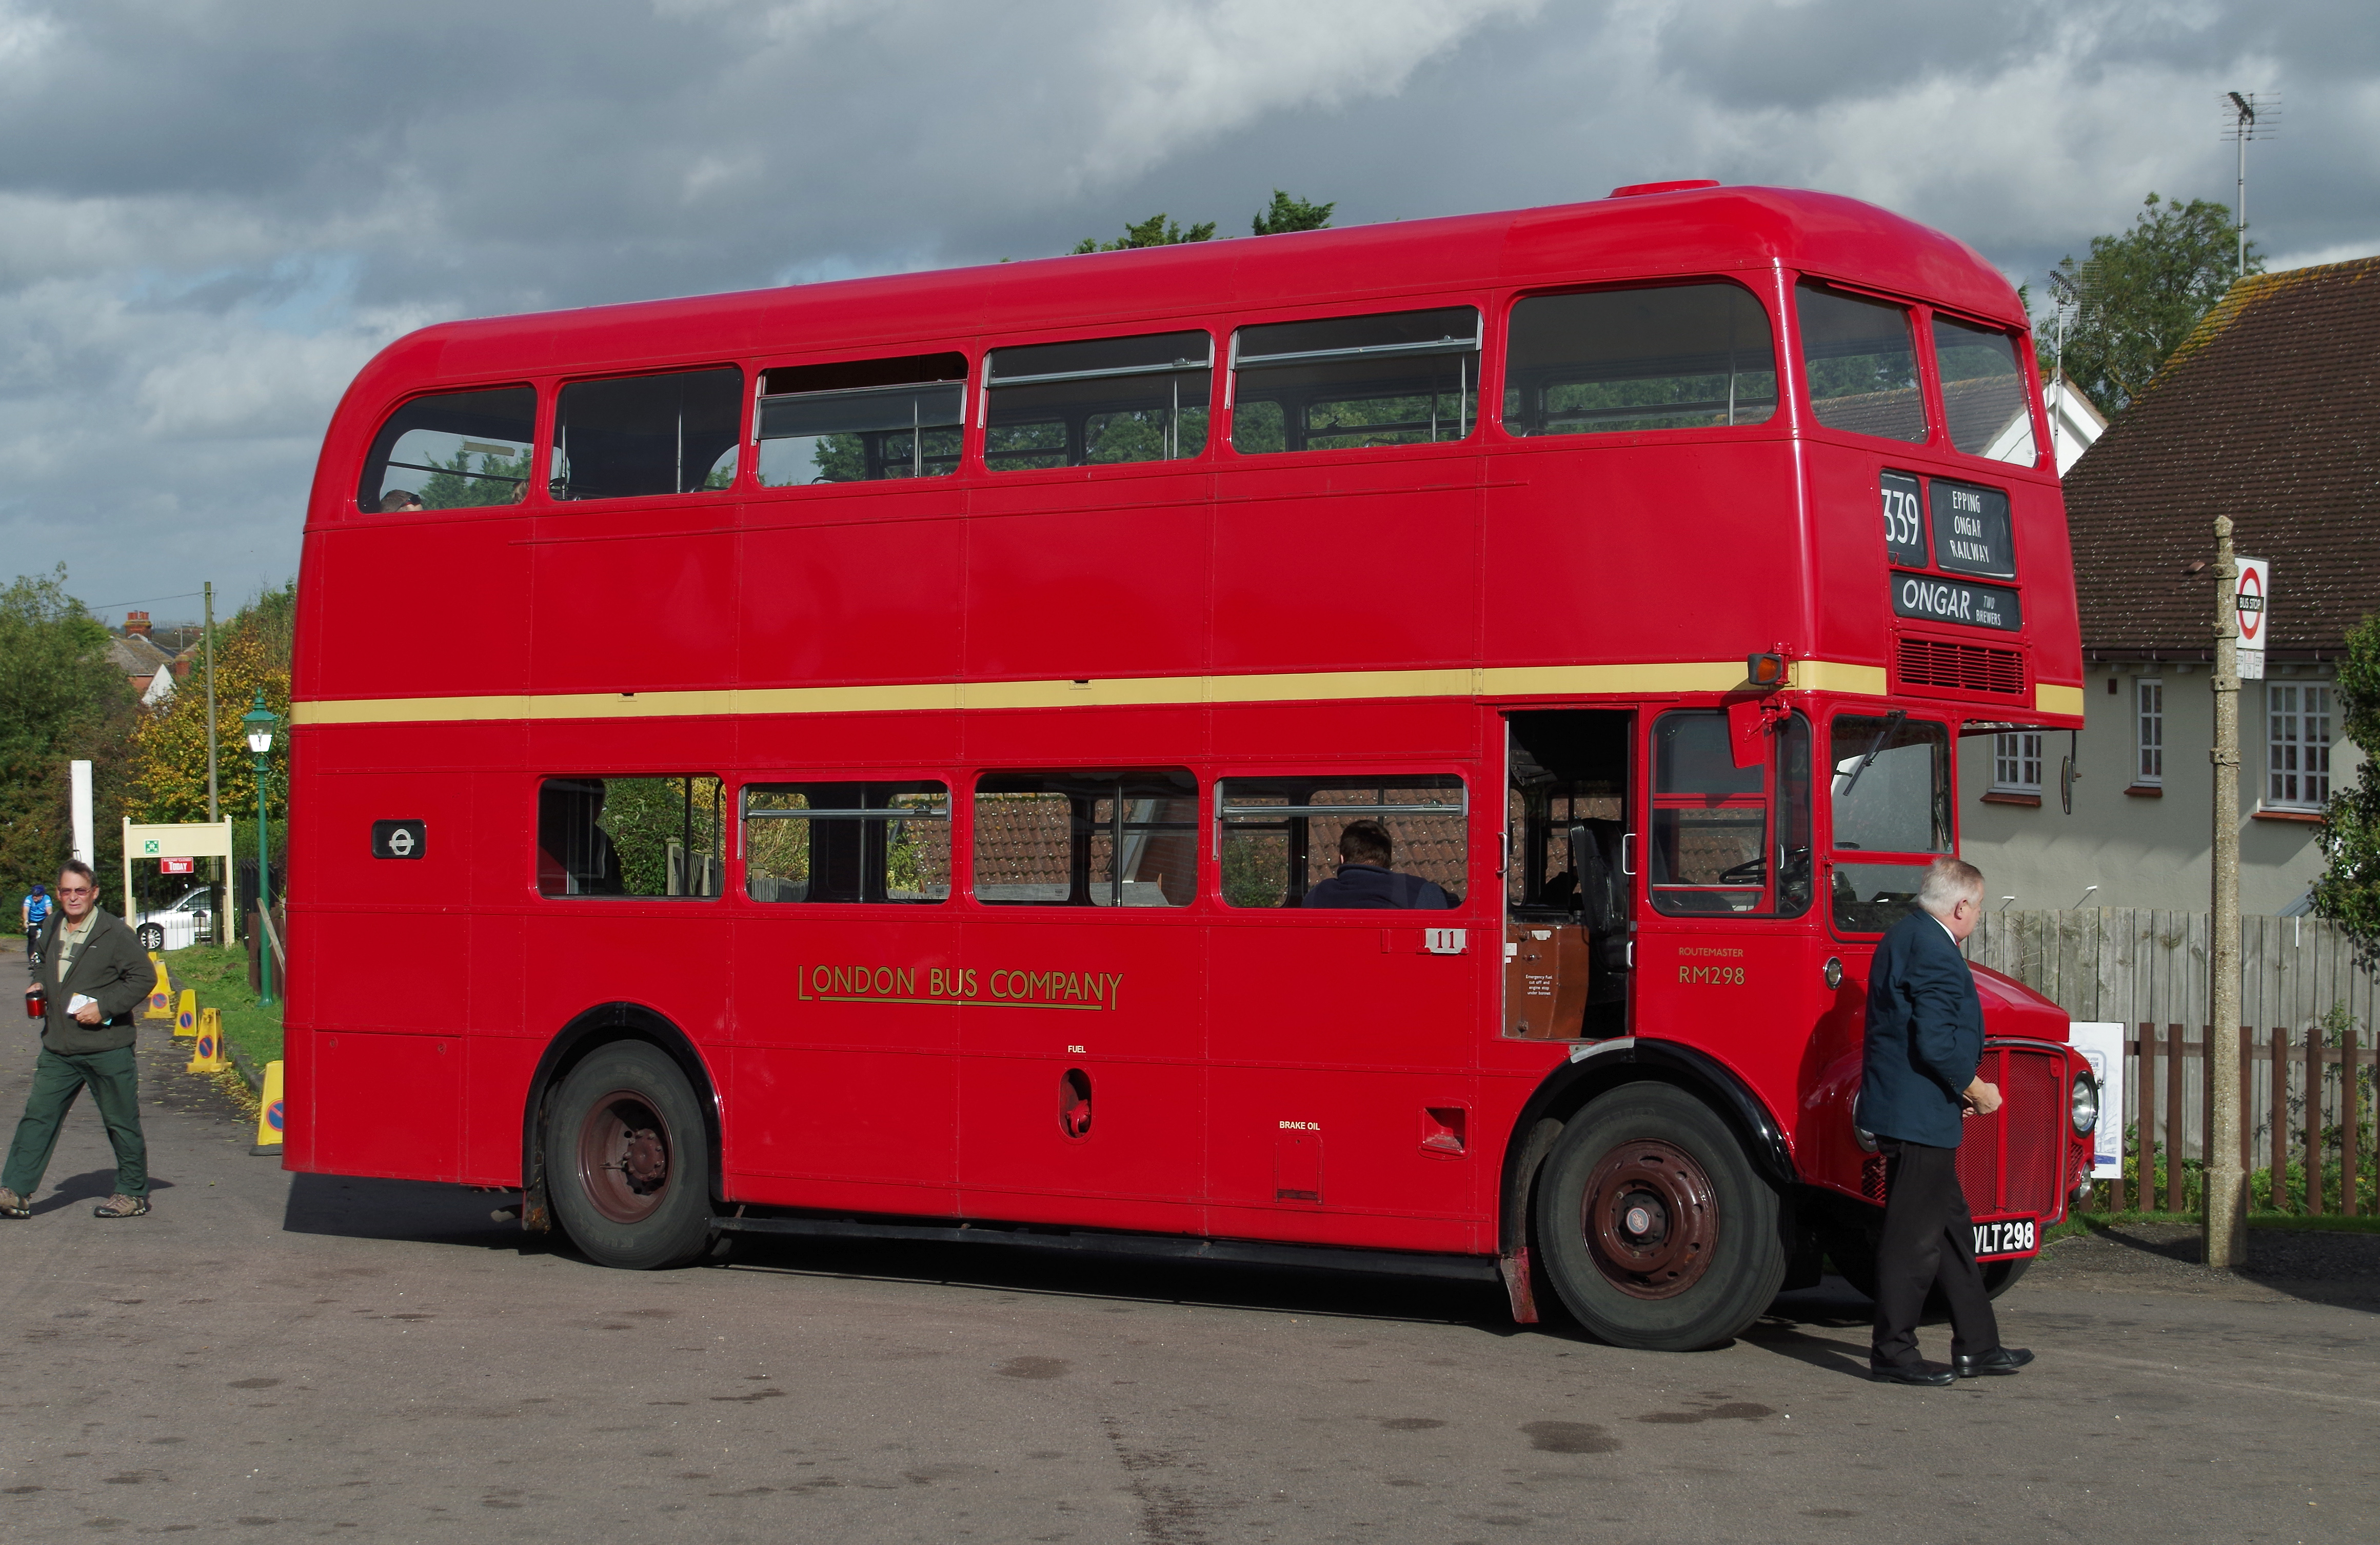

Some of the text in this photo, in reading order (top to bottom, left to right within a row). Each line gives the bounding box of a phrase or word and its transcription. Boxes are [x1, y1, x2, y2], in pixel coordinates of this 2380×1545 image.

[1952, 491, 1980, 513] EPPING
[1881, 489, 1919, 545] 339
[1954, 516, 1981, 538] ONGAR
[1950, 540, 1989, 563] RAILWAY
[1902, 580, 1970, 620] ONGAR
[1984, 596, 1995, 609] TWO
[2239, 597, 2260, 609] BUS STOP
[1976, 609, 2001, 626] BREWERS
[1437, 930, 1455, 949] 11
[1679, 947, 1743, 957] ROUTEMASTER
[1678, 965, 1746, 986] RM298
[798, 964, 1124, 1011] LONDON BUS COMPANY
[1068, 1045, 1086, 1053] FUEL
[1279, 1121, 1320, 1131] BRAKE OIL
[1973, 1221, 2034, 1253] VLT 298
